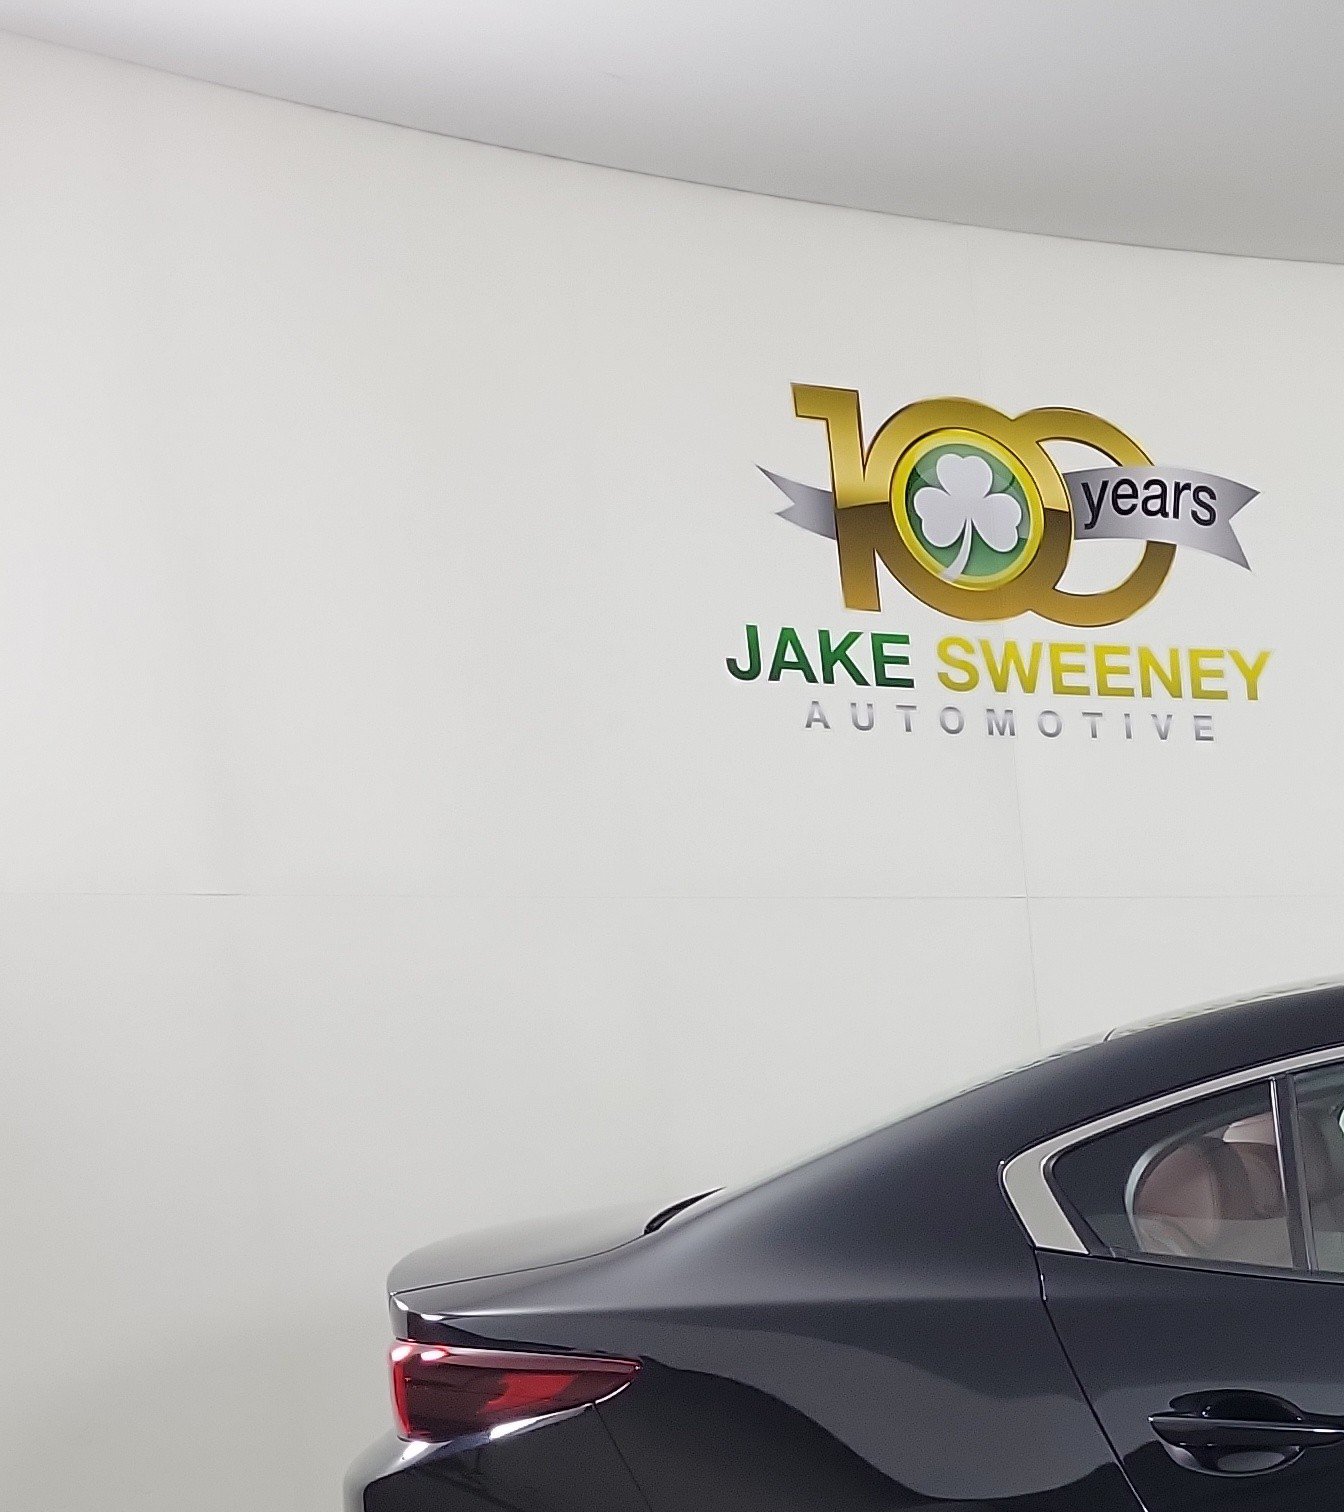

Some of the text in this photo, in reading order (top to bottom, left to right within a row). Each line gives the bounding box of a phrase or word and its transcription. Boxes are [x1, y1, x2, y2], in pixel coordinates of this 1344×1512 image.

[790, 382, 1218, 627] 100 years
[725, 623, 1273, 701] JAKE SWEENEY
[804, 700, 1215, 742] AUTOMOTIVE
